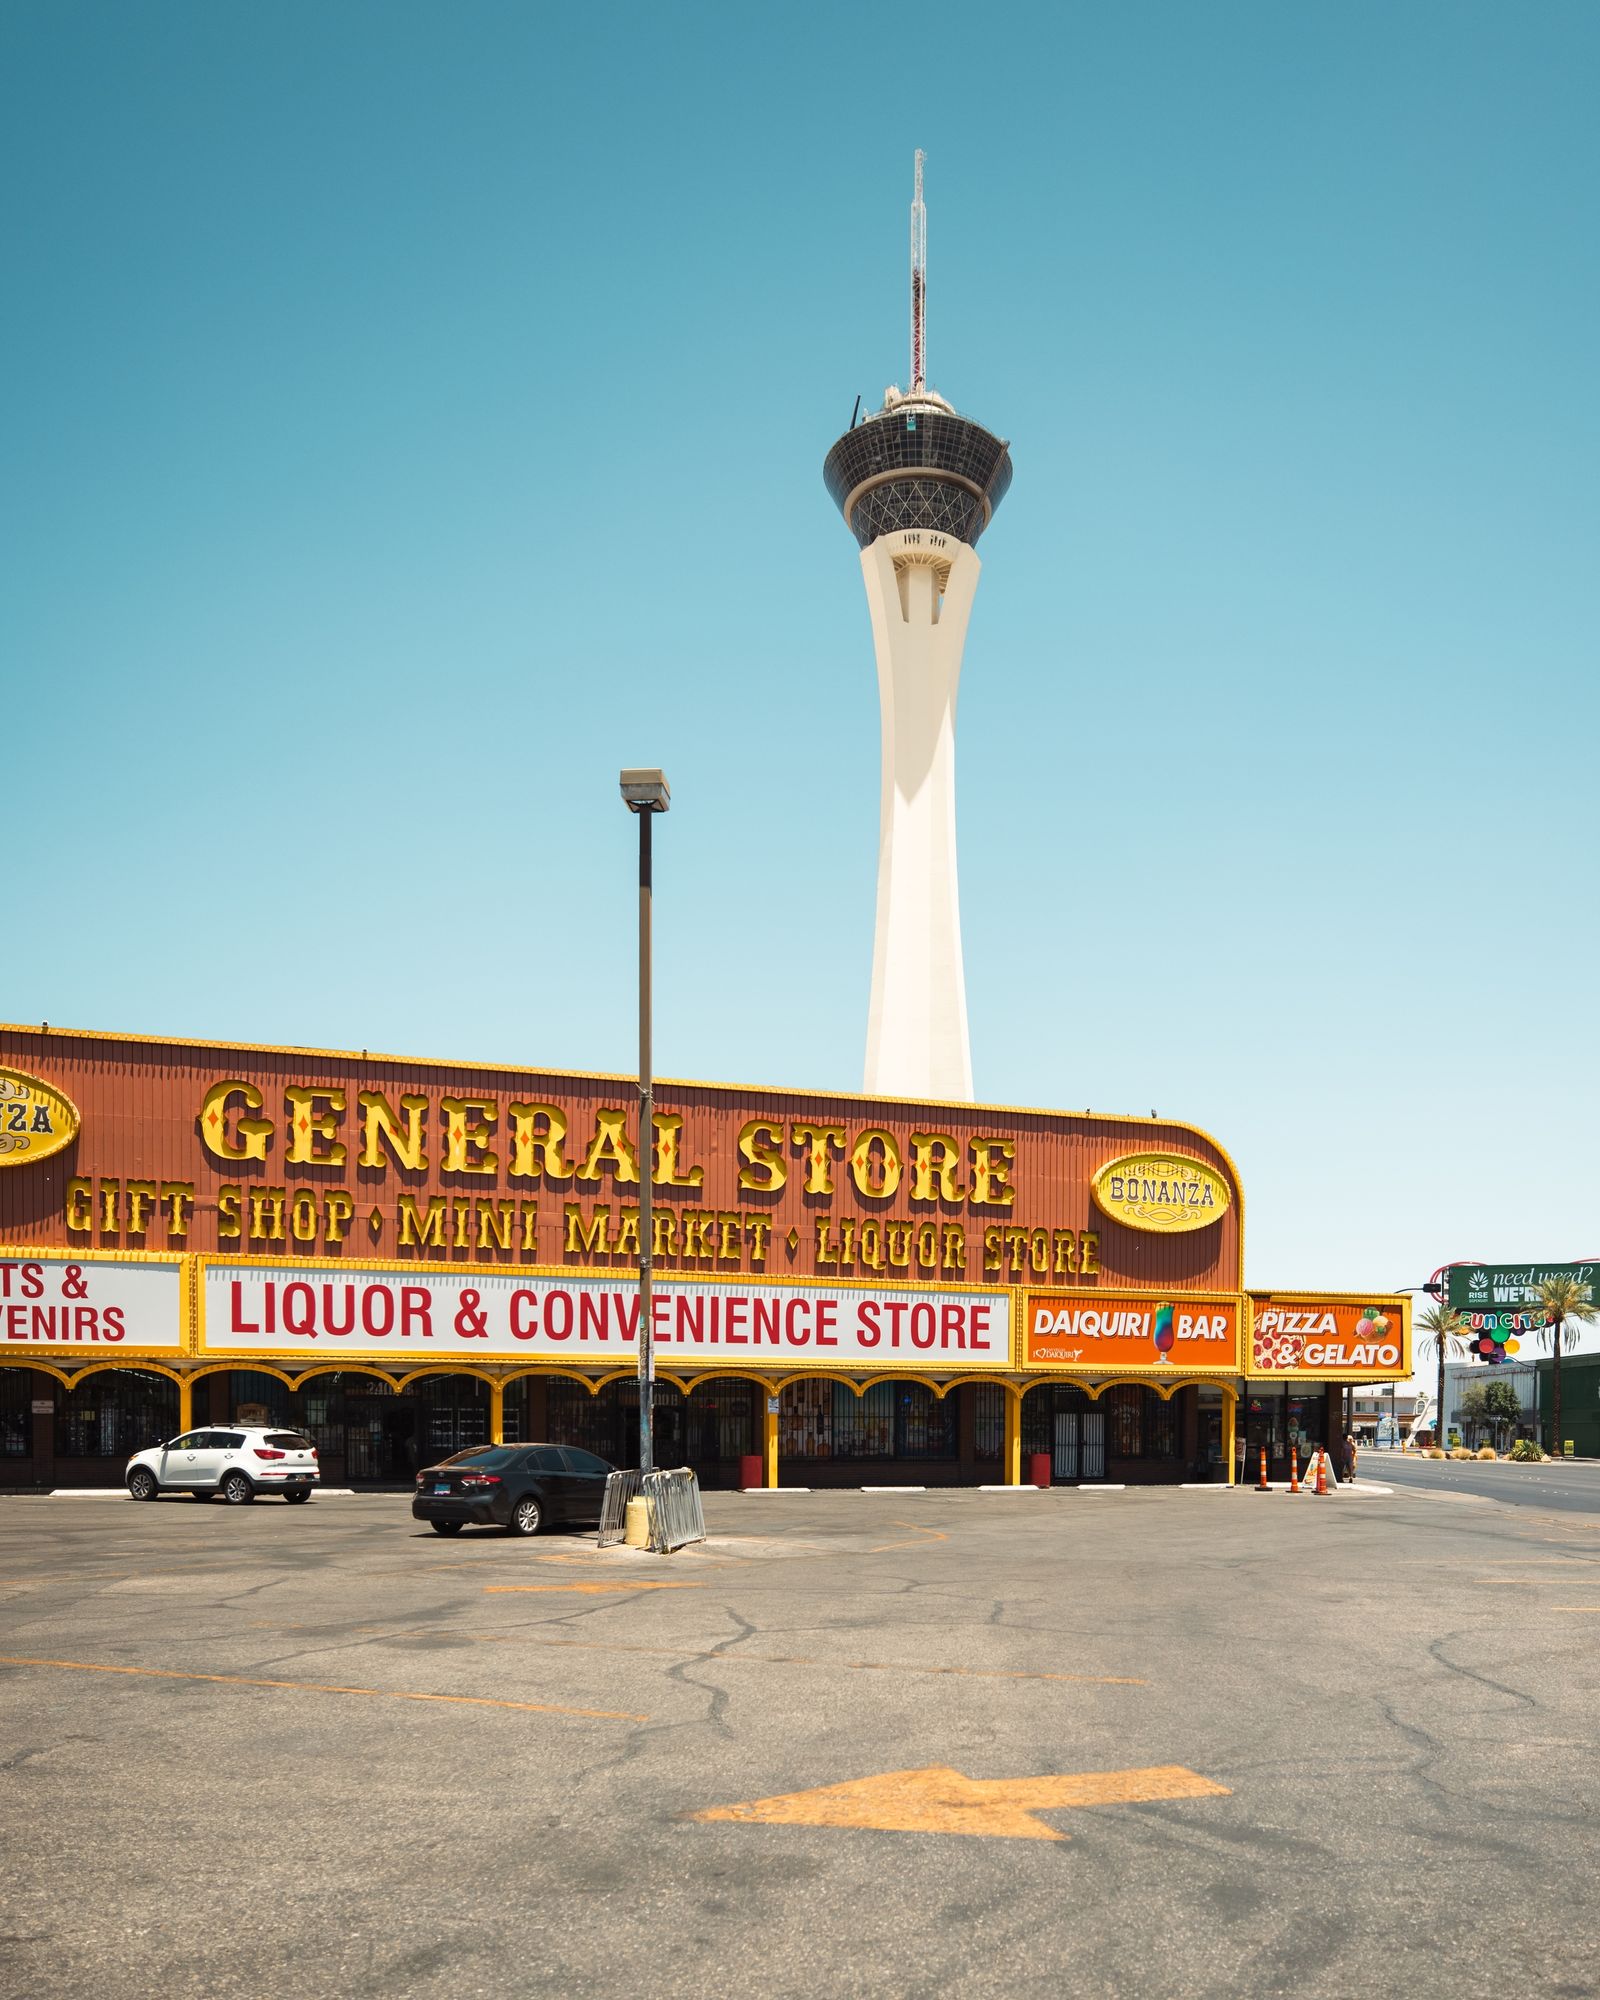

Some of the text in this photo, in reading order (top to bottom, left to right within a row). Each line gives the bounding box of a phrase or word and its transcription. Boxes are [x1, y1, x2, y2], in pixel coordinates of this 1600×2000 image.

[0, 1102, 54, 1134] ZA
[196, 1079, 1016, 1206] GENERAL STORE
[1111, 1176, 1214, 1208] BONANZA
[66, 1175, 1100, 1274] GIFT SHOP MINI MARKET LIQUOR STORE
[61, 1265, 89, 1299] &
[1493, 1267, 1535, 1286] need
[1468, 1291, 1489, 1299] RISE
[0, 1304, 126, 1342] ENIRS
[231, 1280, 991, 1351] LIQUOR & CONVENIENCE STORE
[1034, 1309, 1227, 1340] DAIQUIRI BAR
[1260, 1312, 1338, 1335] PIZZA
[1276, 1343, 1399, 1366] & GELATO
